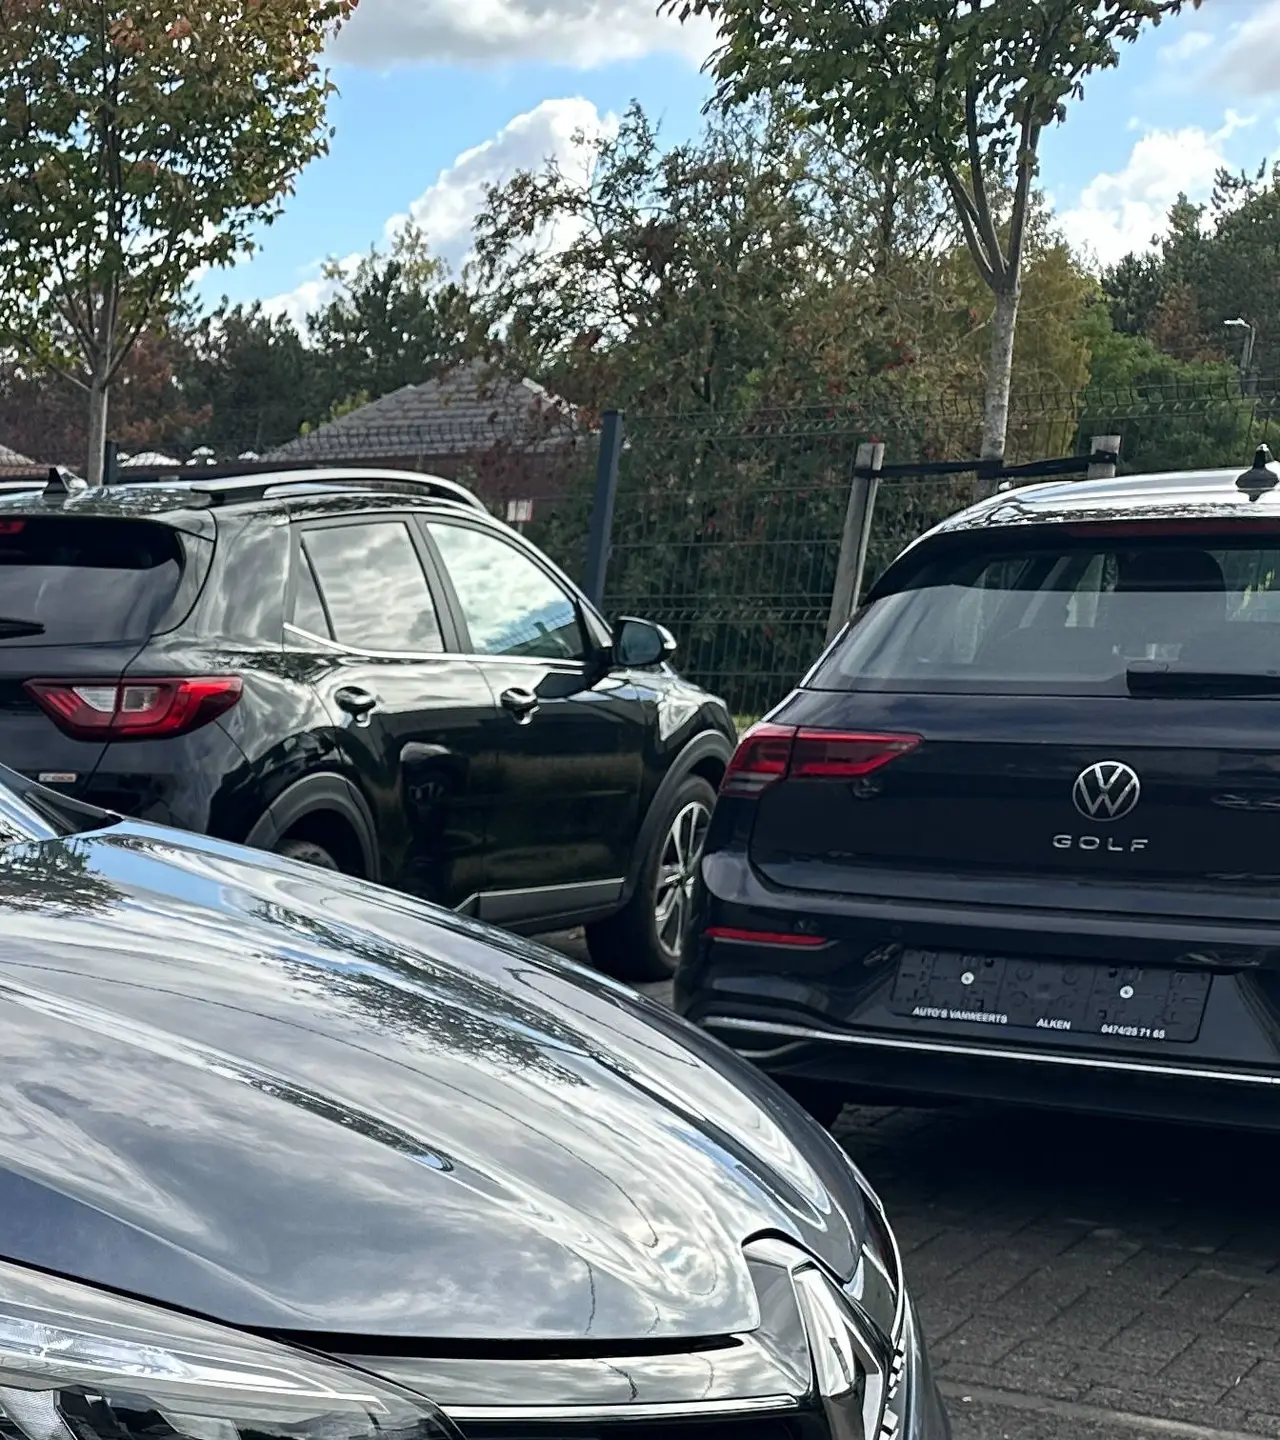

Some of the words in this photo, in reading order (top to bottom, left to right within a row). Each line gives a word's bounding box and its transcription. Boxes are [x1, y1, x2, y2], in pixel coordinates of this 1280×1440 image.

[1052, 834, 1149, 852] GOLF
[949, 1009, 1008, 1024] VANWEERTS
[1036, 1018, 1072, 1030] ALKEN
